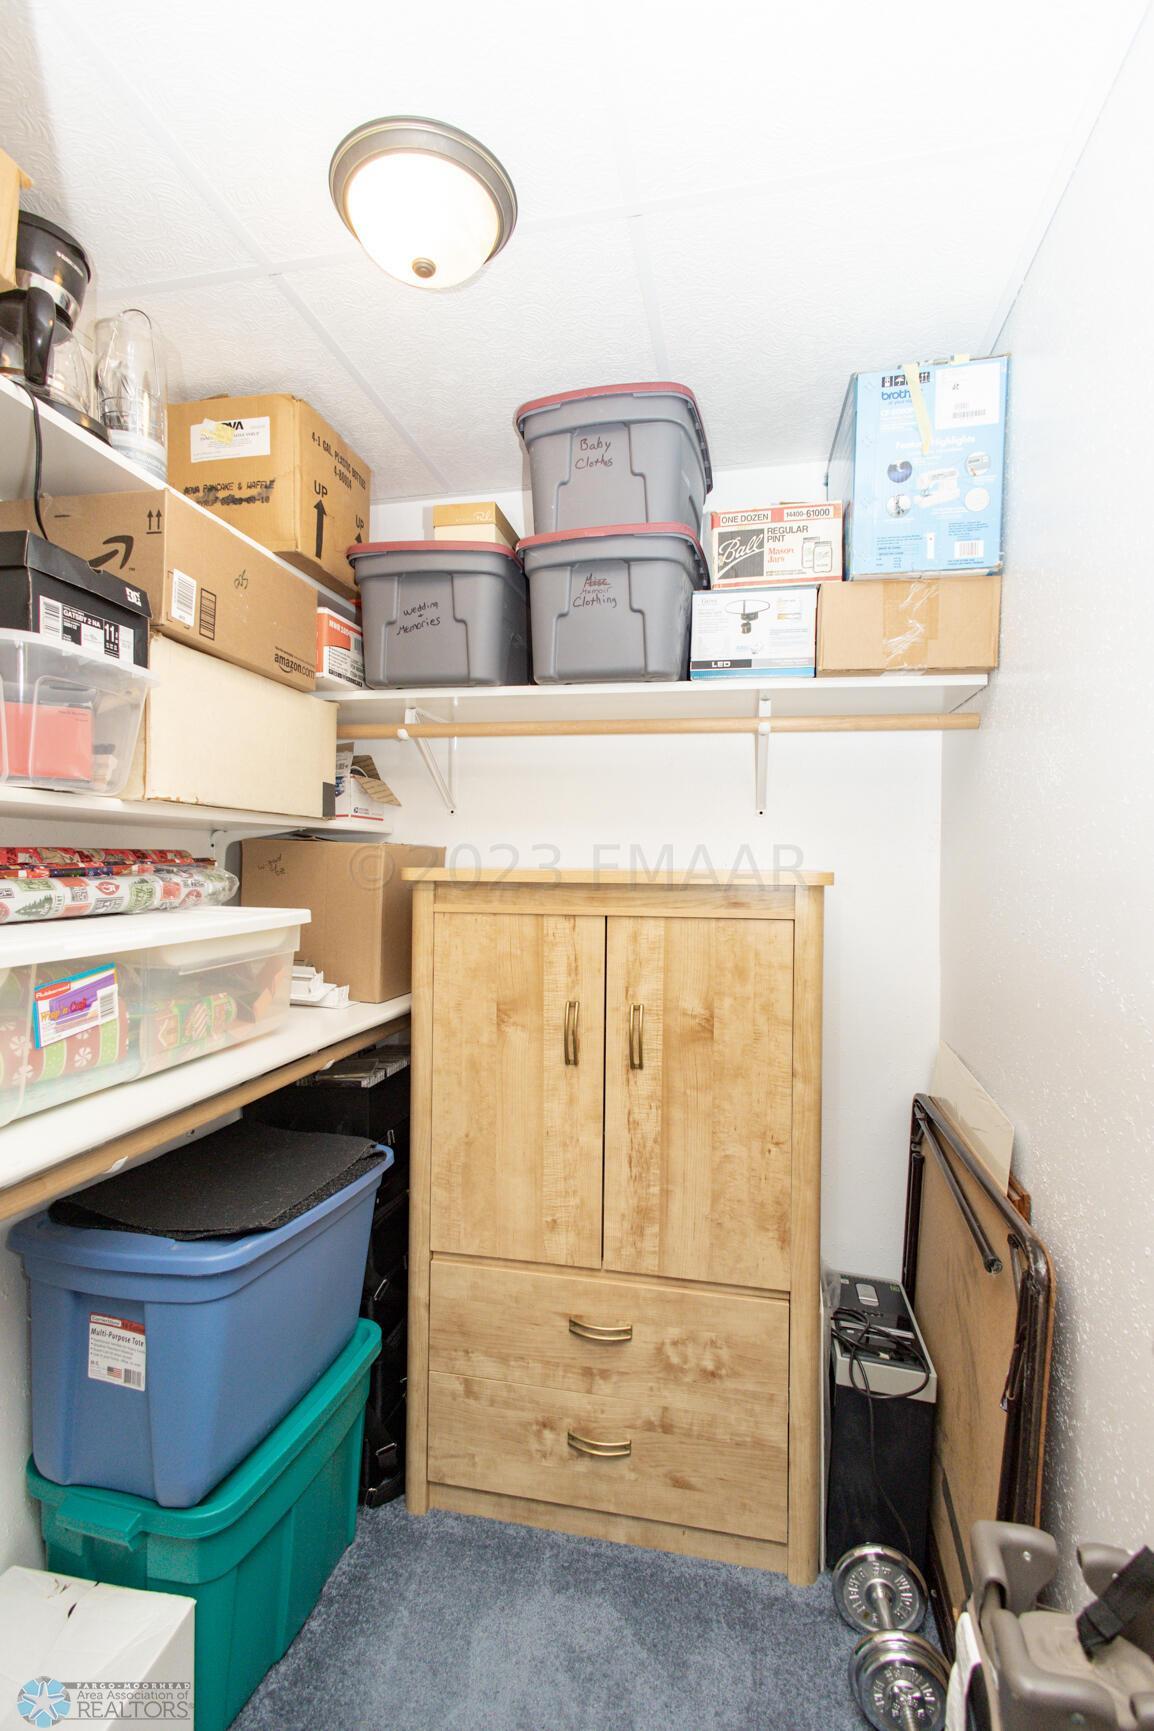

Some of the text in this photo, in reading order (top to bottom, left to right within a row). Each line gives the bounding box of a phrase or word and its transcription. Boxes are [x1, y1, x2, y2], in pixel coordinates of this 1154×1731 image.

[881, 389, 914, 400] broth
[580, 436, 611, 453] Baby
[246, 479, 275, 490] WAFFLE
[314, 480, 328, 498] UP
[355, 514, 365, 529] UP
[721, 515, 739, 524] ONE
[741, 513, 769, 523] DOZEN
[718, 525, 809, 563] Ball REGULAR
[767, 535, 786, 543] PINT
[768, 546, 795, 555] Mason
[767, 555, 785, 564] Jars
[572, 593, 617, 609] Clothing
[63, 609, 87, 623] GATSBY
[396, 616, 441, 636] Memories
[274, 652, 315, 681] amazon.com
[91, 1327, 144, 1347] Multi-Purpose Tote
